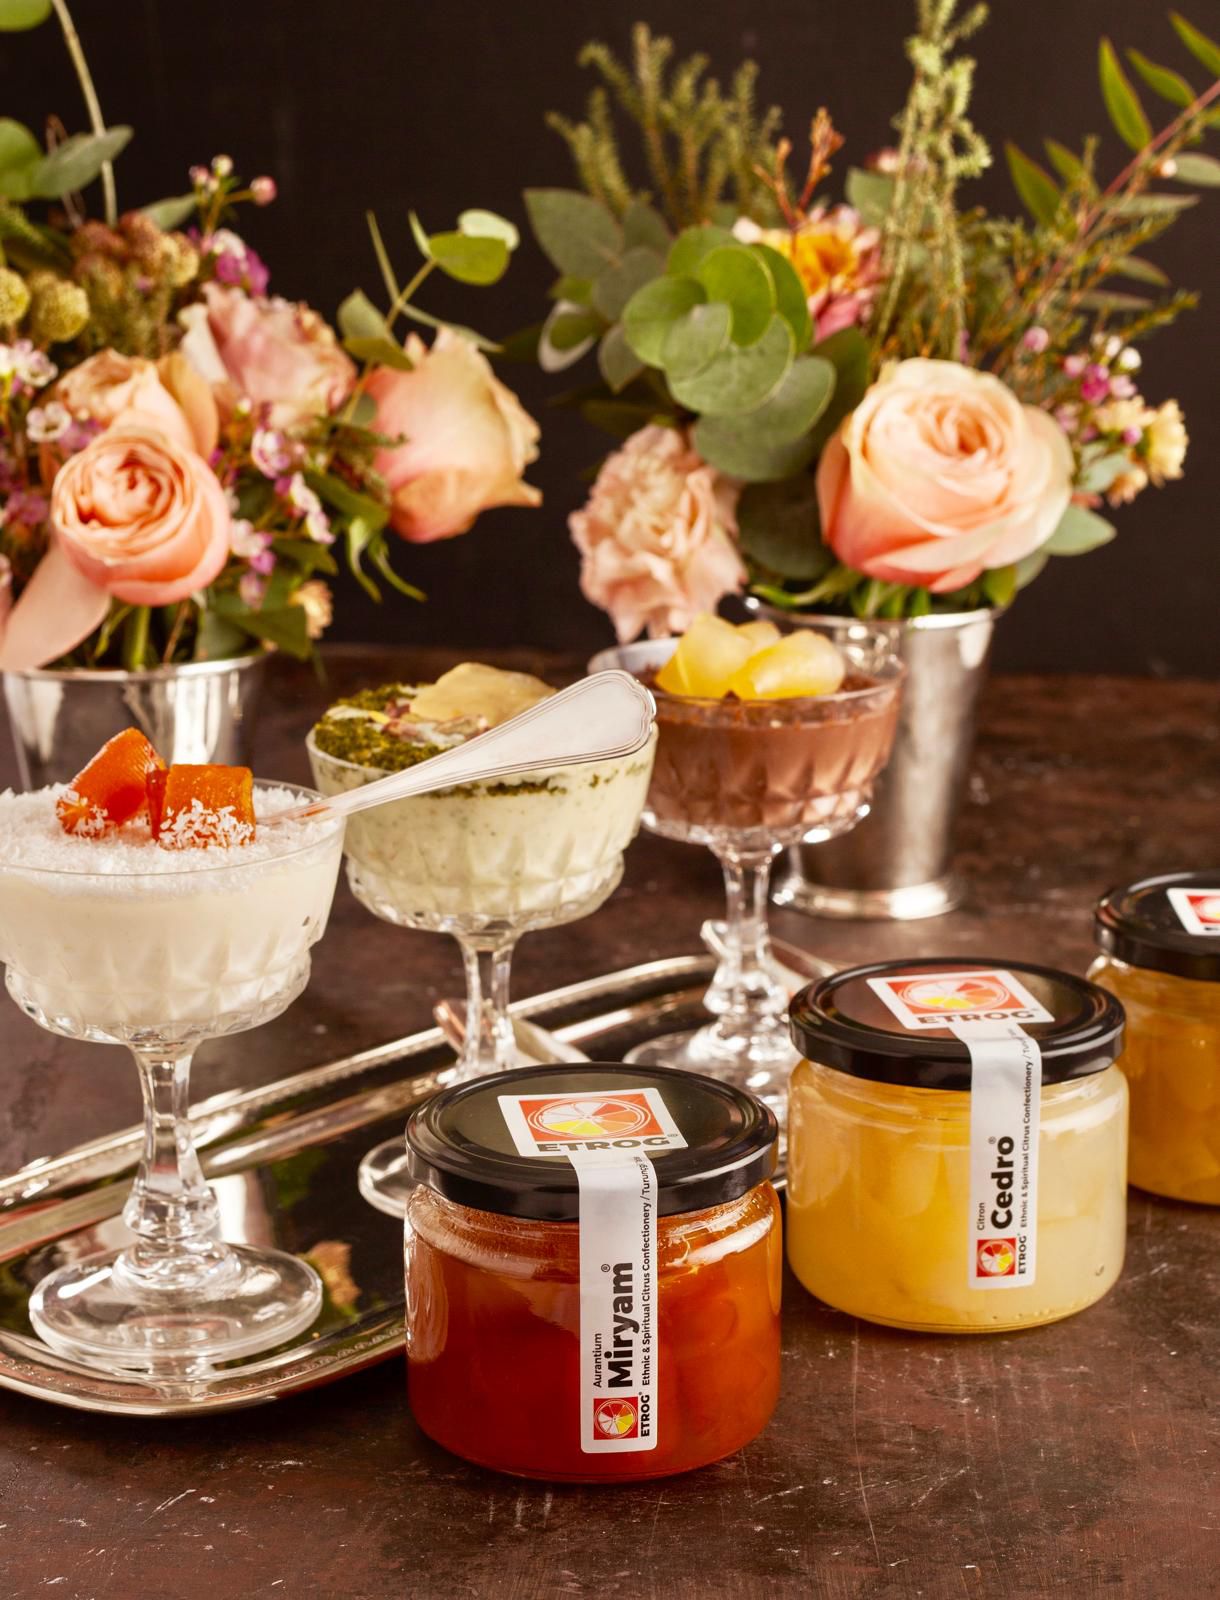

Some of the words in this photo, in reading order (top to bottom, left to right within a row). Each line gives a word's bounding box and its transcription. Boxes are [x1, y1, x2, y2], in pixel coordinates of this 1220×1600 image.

[1023, 1061, 1033, 1123] Confectionery
[1022, 1125, 1030, 1152] Citrus
[1021, 1153, 1030, 1191] Spiritual
[976, 1202, 985, 1231] Citron
[1020, 1200, 1028, 1228] Ethnic
[641, 1202, 652, 1271] Confectionery
[1018, 1235, 1027, 1274] ETROG
[642, 1272, 651, 1301] Citrus
[642, 1303, 652, 1345] Spiritual
[592, 1332, 602, 1388] Aurantium
[642, 1346, 651, 1354] &
[642, 1355, 651, 1386] Ethnic
